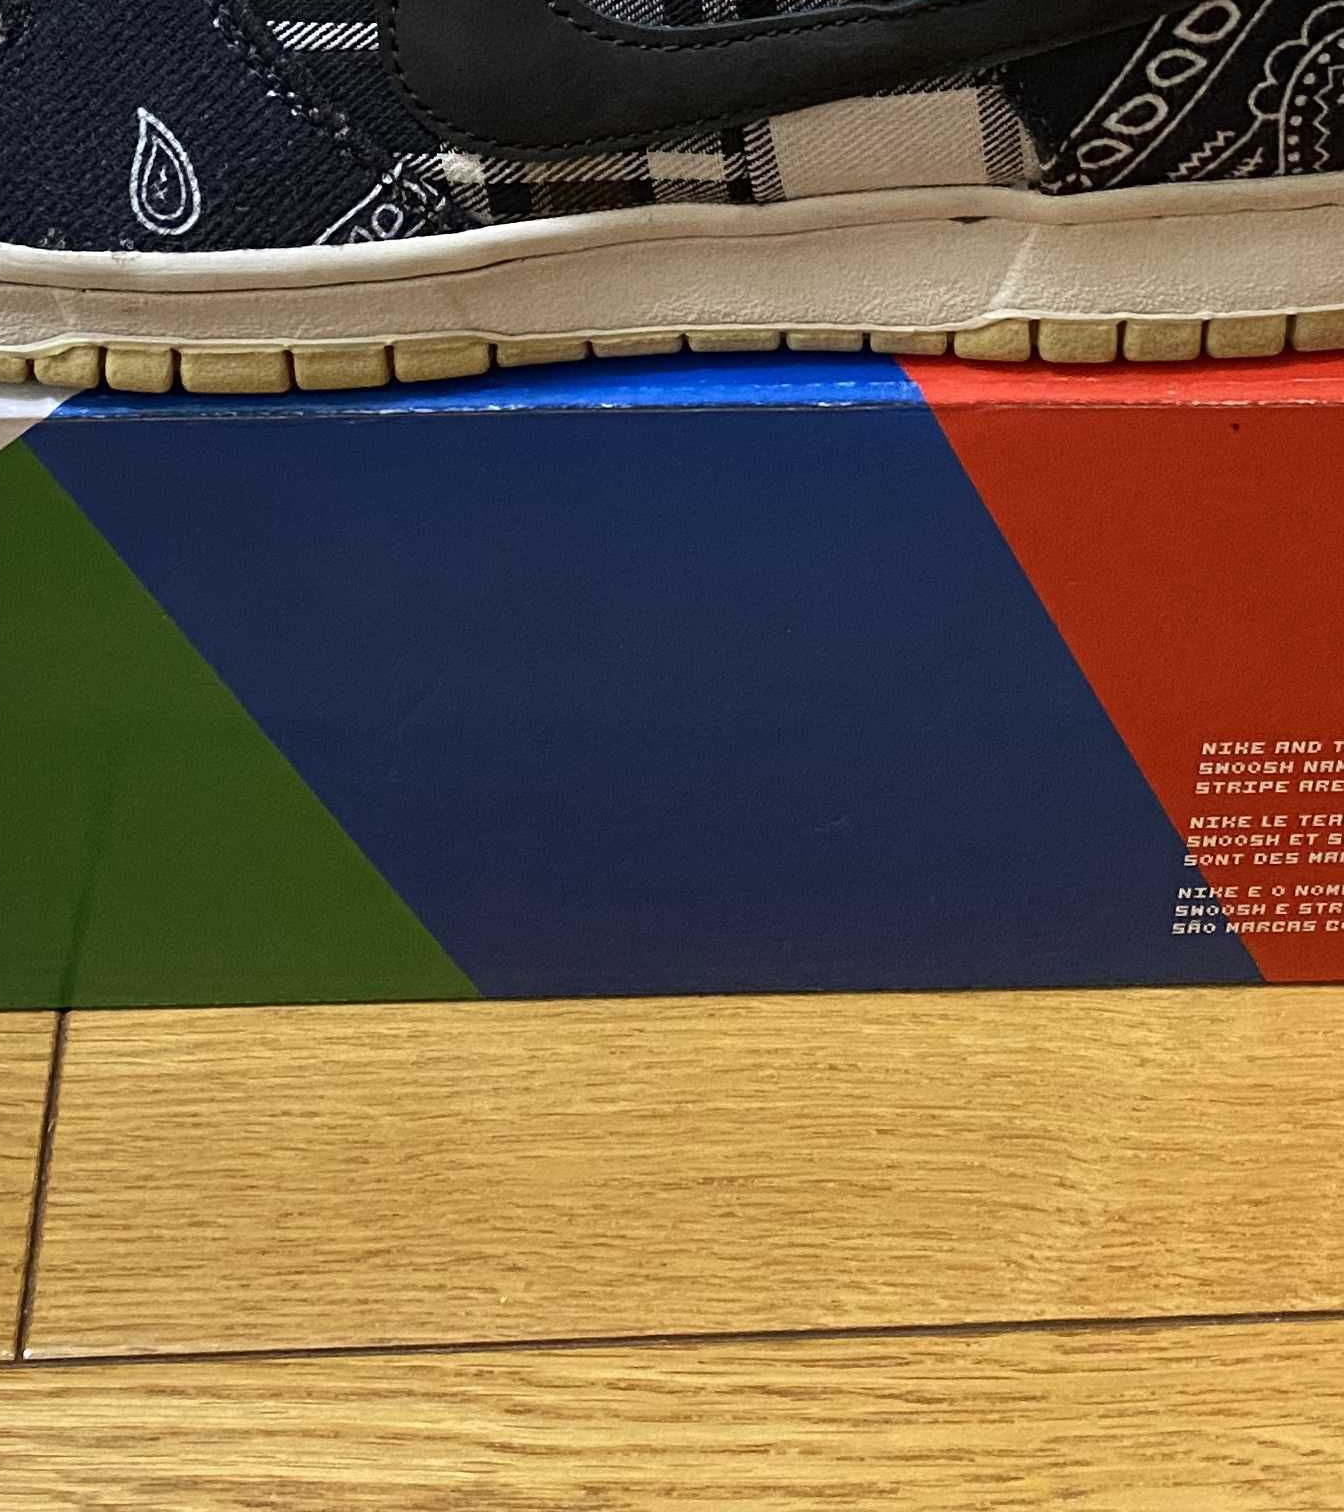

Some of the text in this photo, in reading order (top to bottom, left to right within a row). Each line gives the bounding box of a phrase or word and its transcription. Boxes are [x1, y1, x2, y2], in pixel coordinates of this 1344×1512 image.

[1201, 742, 1266, 756] NIKE
[1274, 740, 1323, 755] AND
[1198, 761, 1295, 775] SWOOSH
[1194, 780, 1291, 795] STRIPE
[1189, 815, 1253, 830] NIKE
[1260, 814, 1289, 828] LE
[1185, 833, 1281, 848] SWOOSH
[1288, 833, 1320, 846] ET
[1183, 853, 1245, 867] SONT
[1253, 852, 1300, 866] DES
[1177, 885, 1240, 900] NIKE
[1247, 885, 1262, 898] E
[1271, 884, 1286, 897] O
[1174, 903, 1267, 918] SWOOSH
[1274, 903, 1291, 916] E
[1171, 919, 1217, 935] SÃO
[1225, 920, 1318, 934] MARCAS
